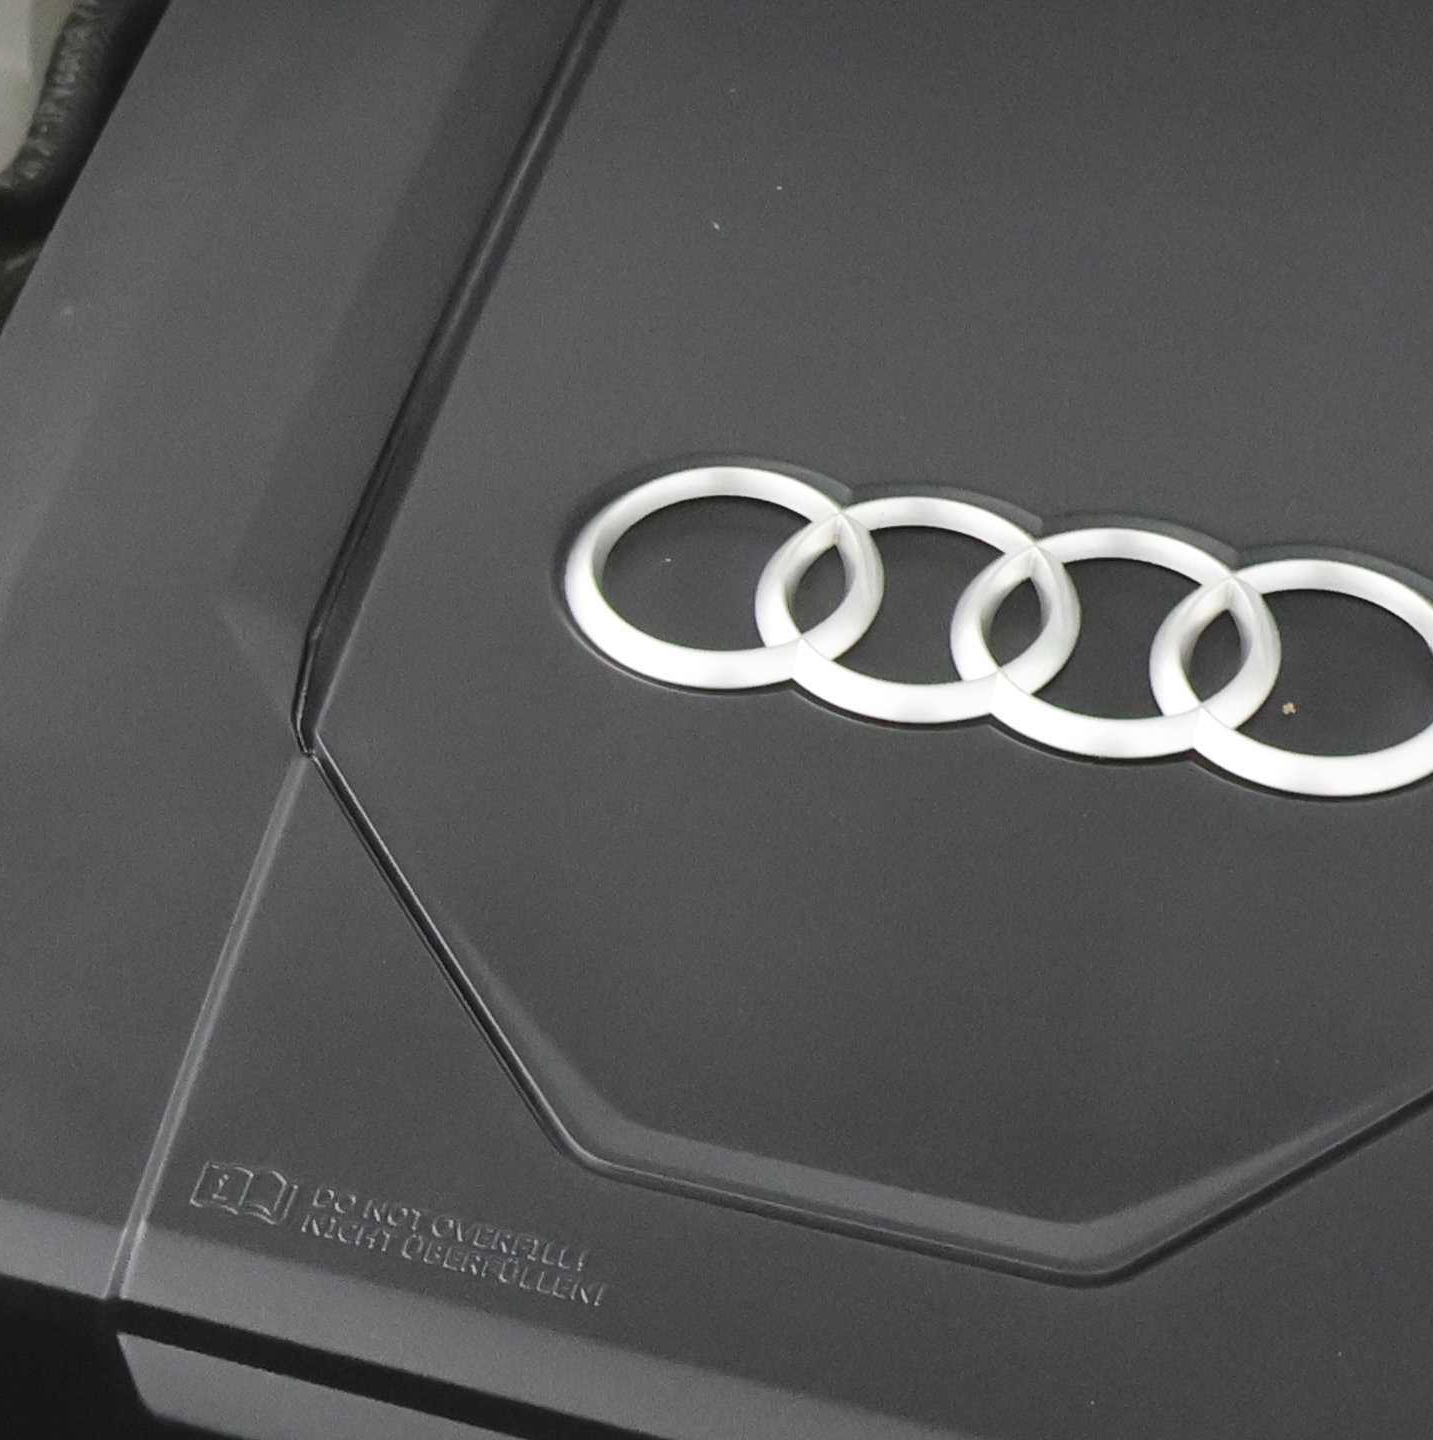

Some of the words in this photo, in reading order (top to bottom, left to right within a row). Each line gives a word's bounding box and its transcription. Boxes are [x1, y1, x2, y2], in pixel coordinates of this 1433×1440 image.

[311, 1184, 357, 1215] DO
[362, 1199, 421, 1231] NOT
[300, 1213, 391, 1253] NICHT
